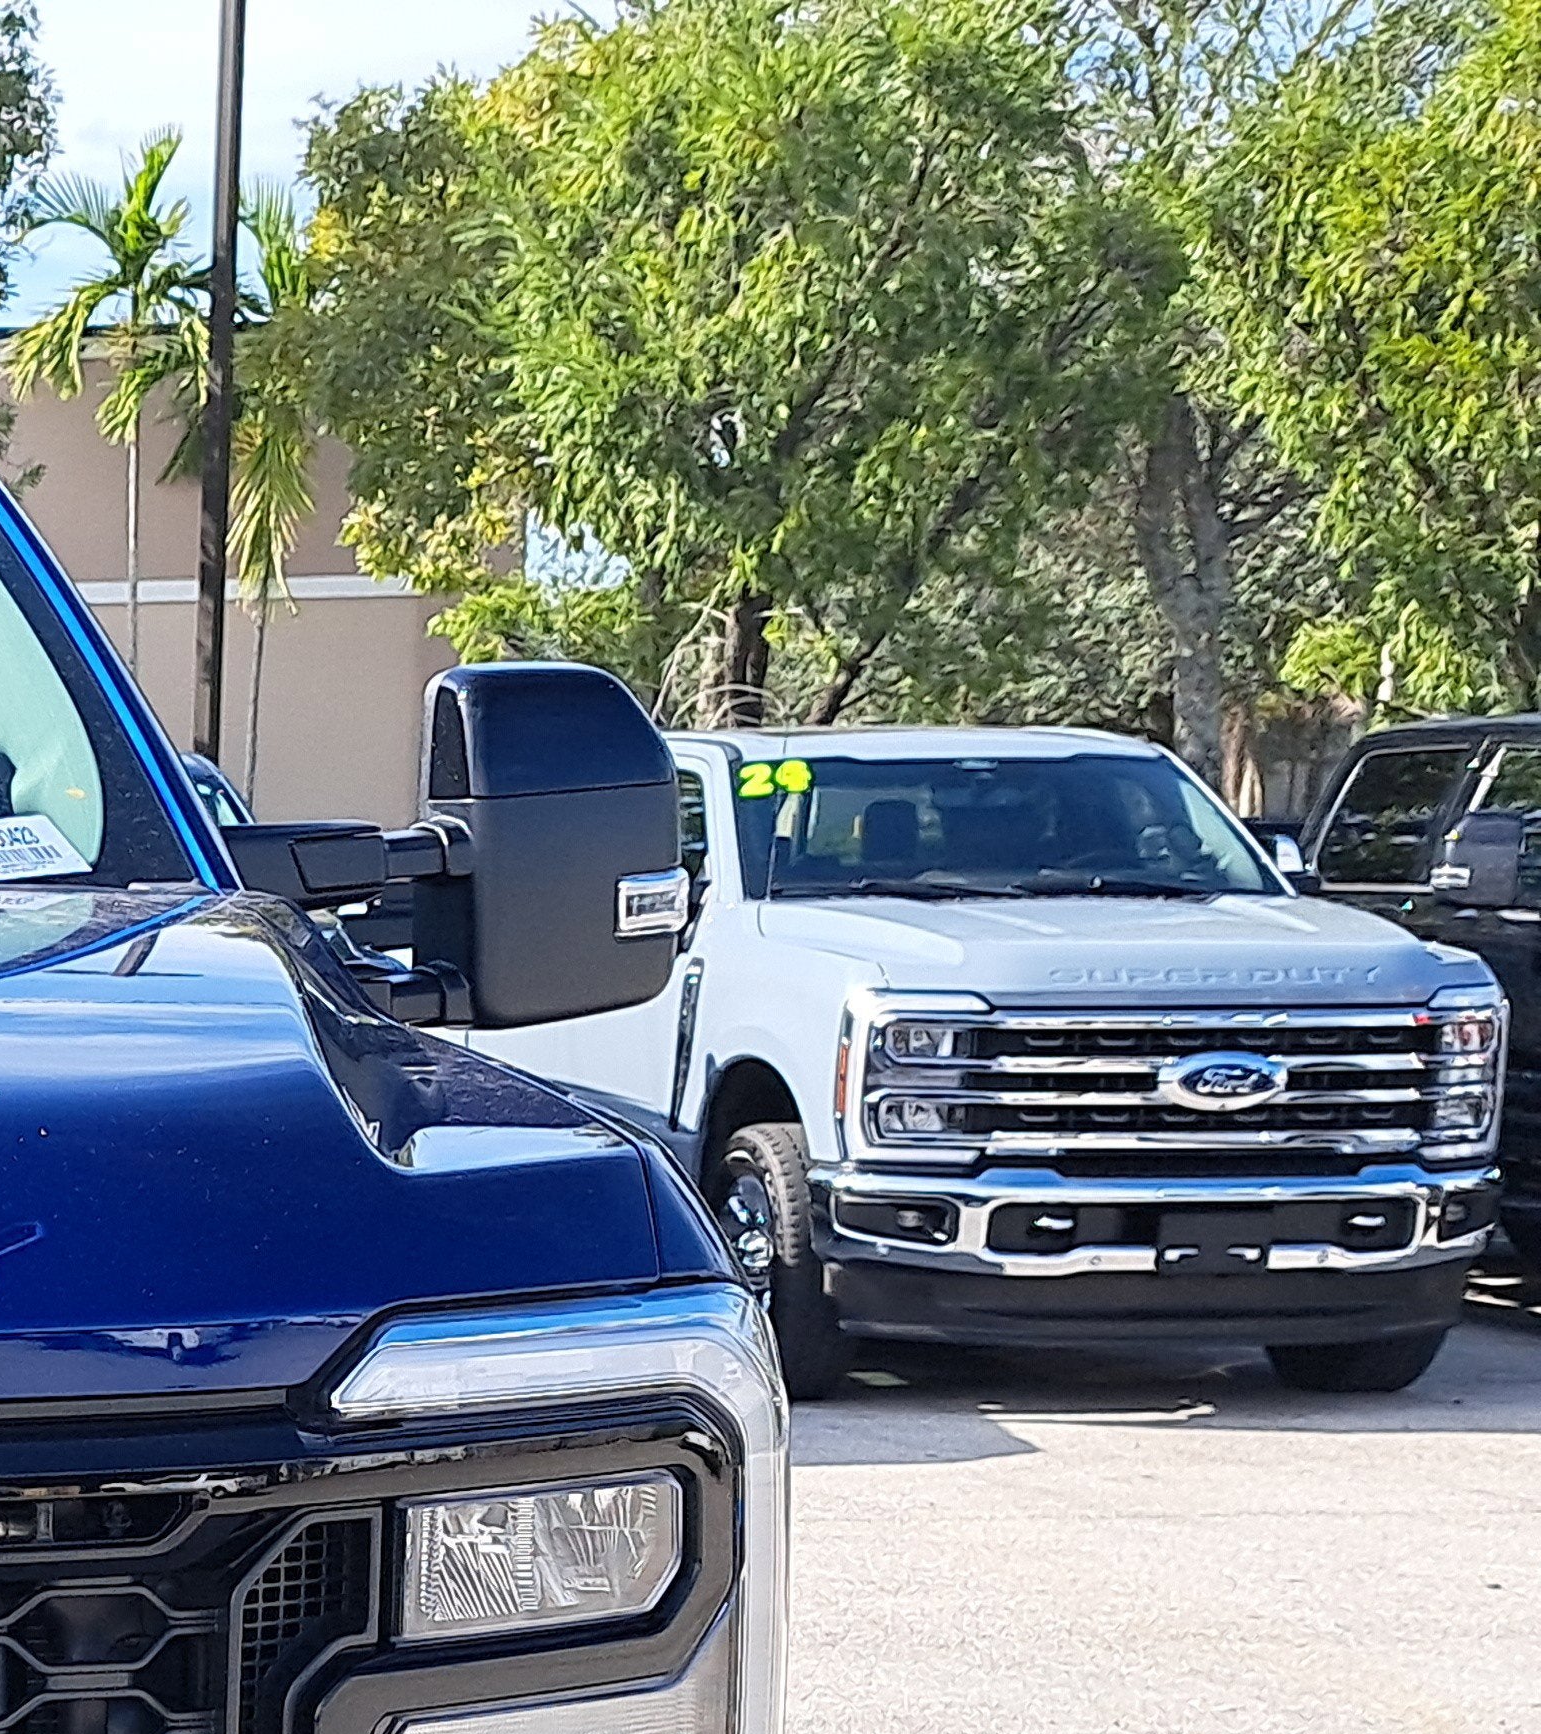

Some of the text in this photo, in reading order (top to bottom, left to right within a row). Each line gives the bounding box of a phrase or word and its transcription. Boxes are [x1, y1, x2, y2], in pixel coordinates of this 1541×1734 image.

[1049, 965, 1381, 986] SUPER DUTY
[1196, 1067, 1260, 1094] Ford
